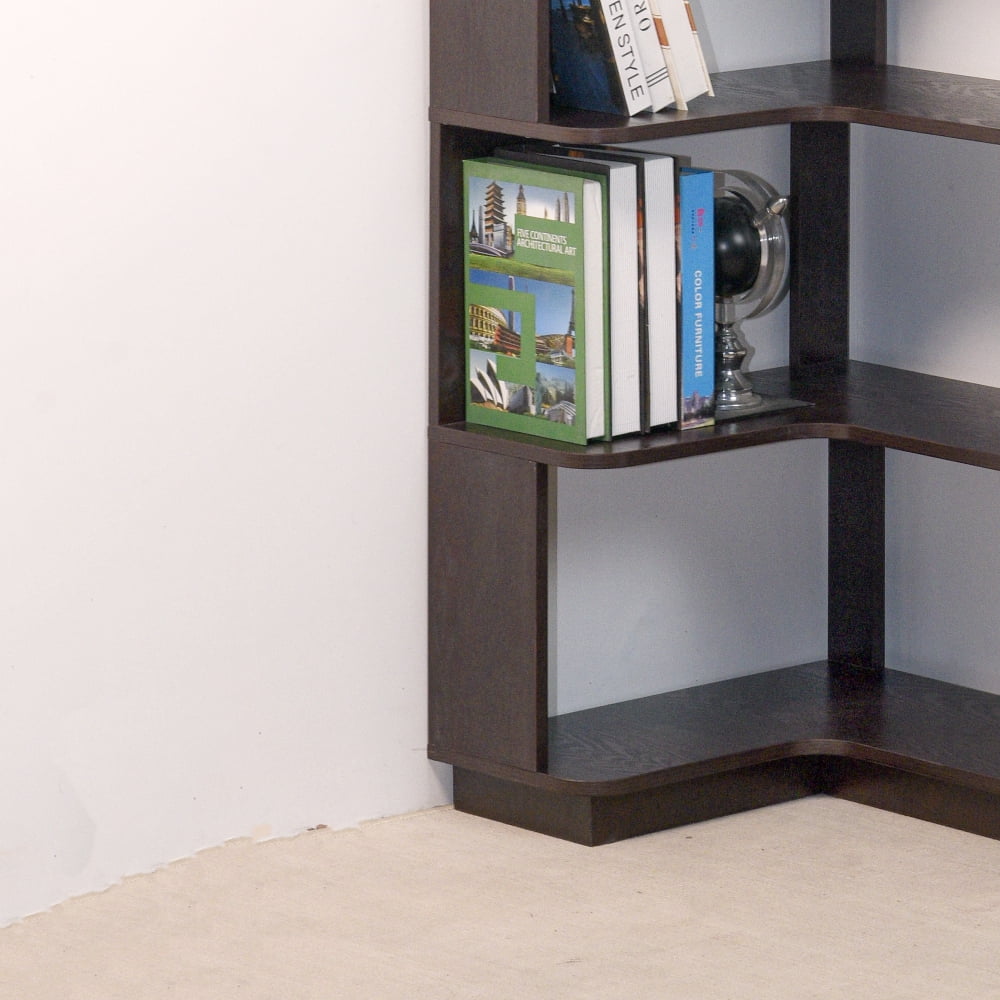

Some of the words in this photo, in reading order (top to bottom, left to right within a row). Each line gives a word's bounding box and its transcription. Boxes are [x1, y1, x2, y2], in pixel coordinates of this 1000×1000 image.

[618, 34, 644, 101] STYLE
[516, 238, 563, 254] ARCHITECTURAL
[564, 246, 576, 256] ART
[517, 228, 529, 240] FIVE
[530, 230, 567, 246] CONTINENTS
[694, 312, 702, 378] FURNITURE
